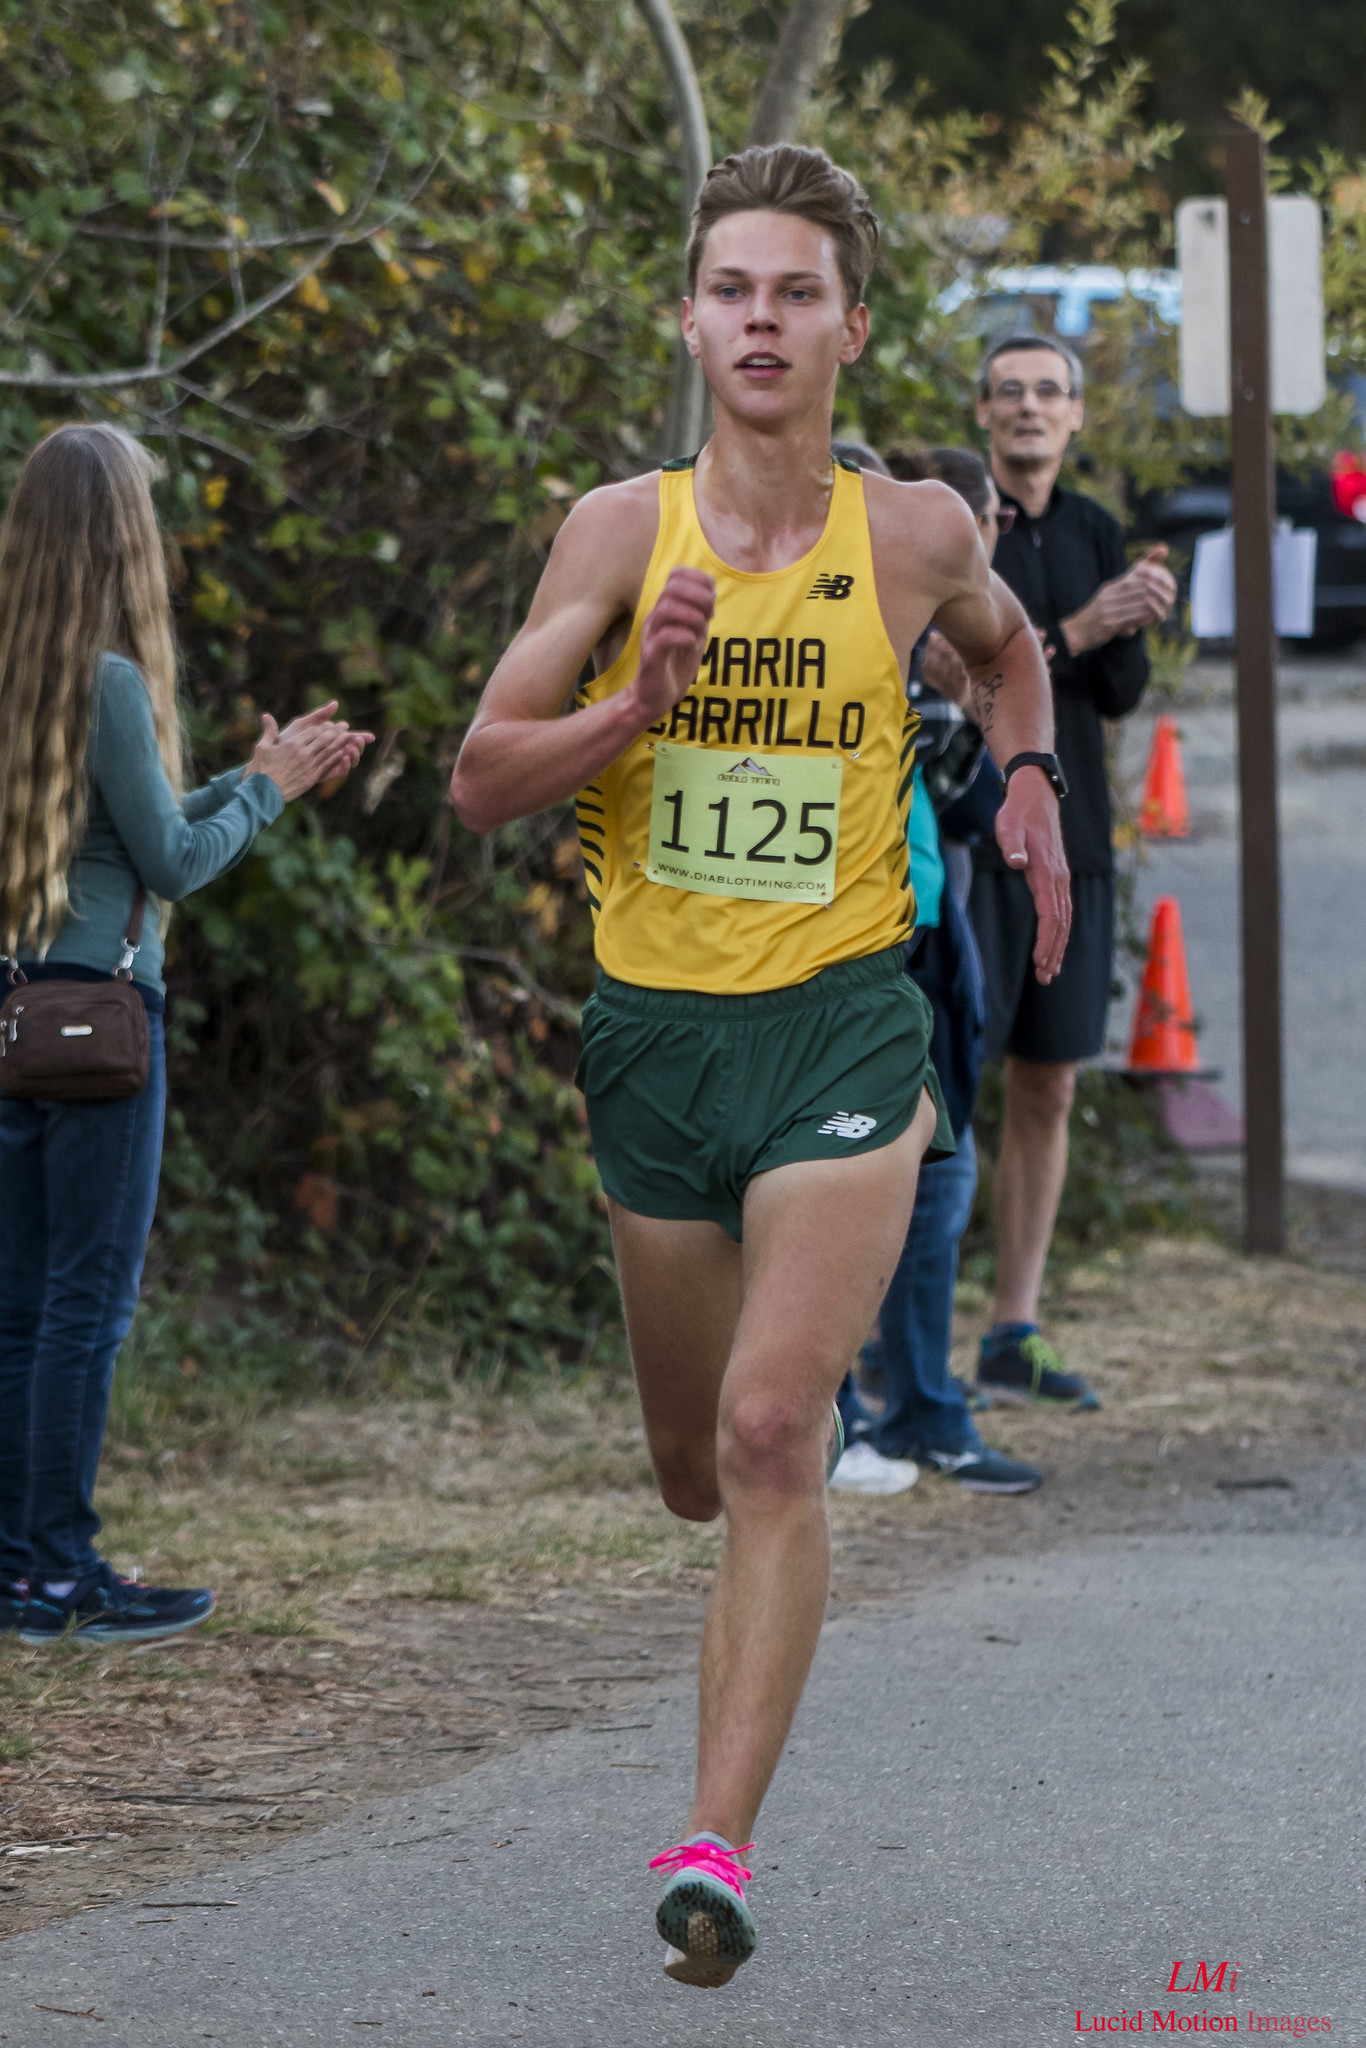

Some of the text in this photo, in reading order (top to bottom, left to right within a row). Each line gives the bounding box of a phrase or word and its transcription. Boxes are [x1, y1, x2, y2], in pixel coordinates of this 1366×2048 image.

[646, 696, 866, 751] ARRILLO
[660, 789, 836, 867] 1125
[658, 863, 826, 891] WWW.DIABLOTIMING.COM
